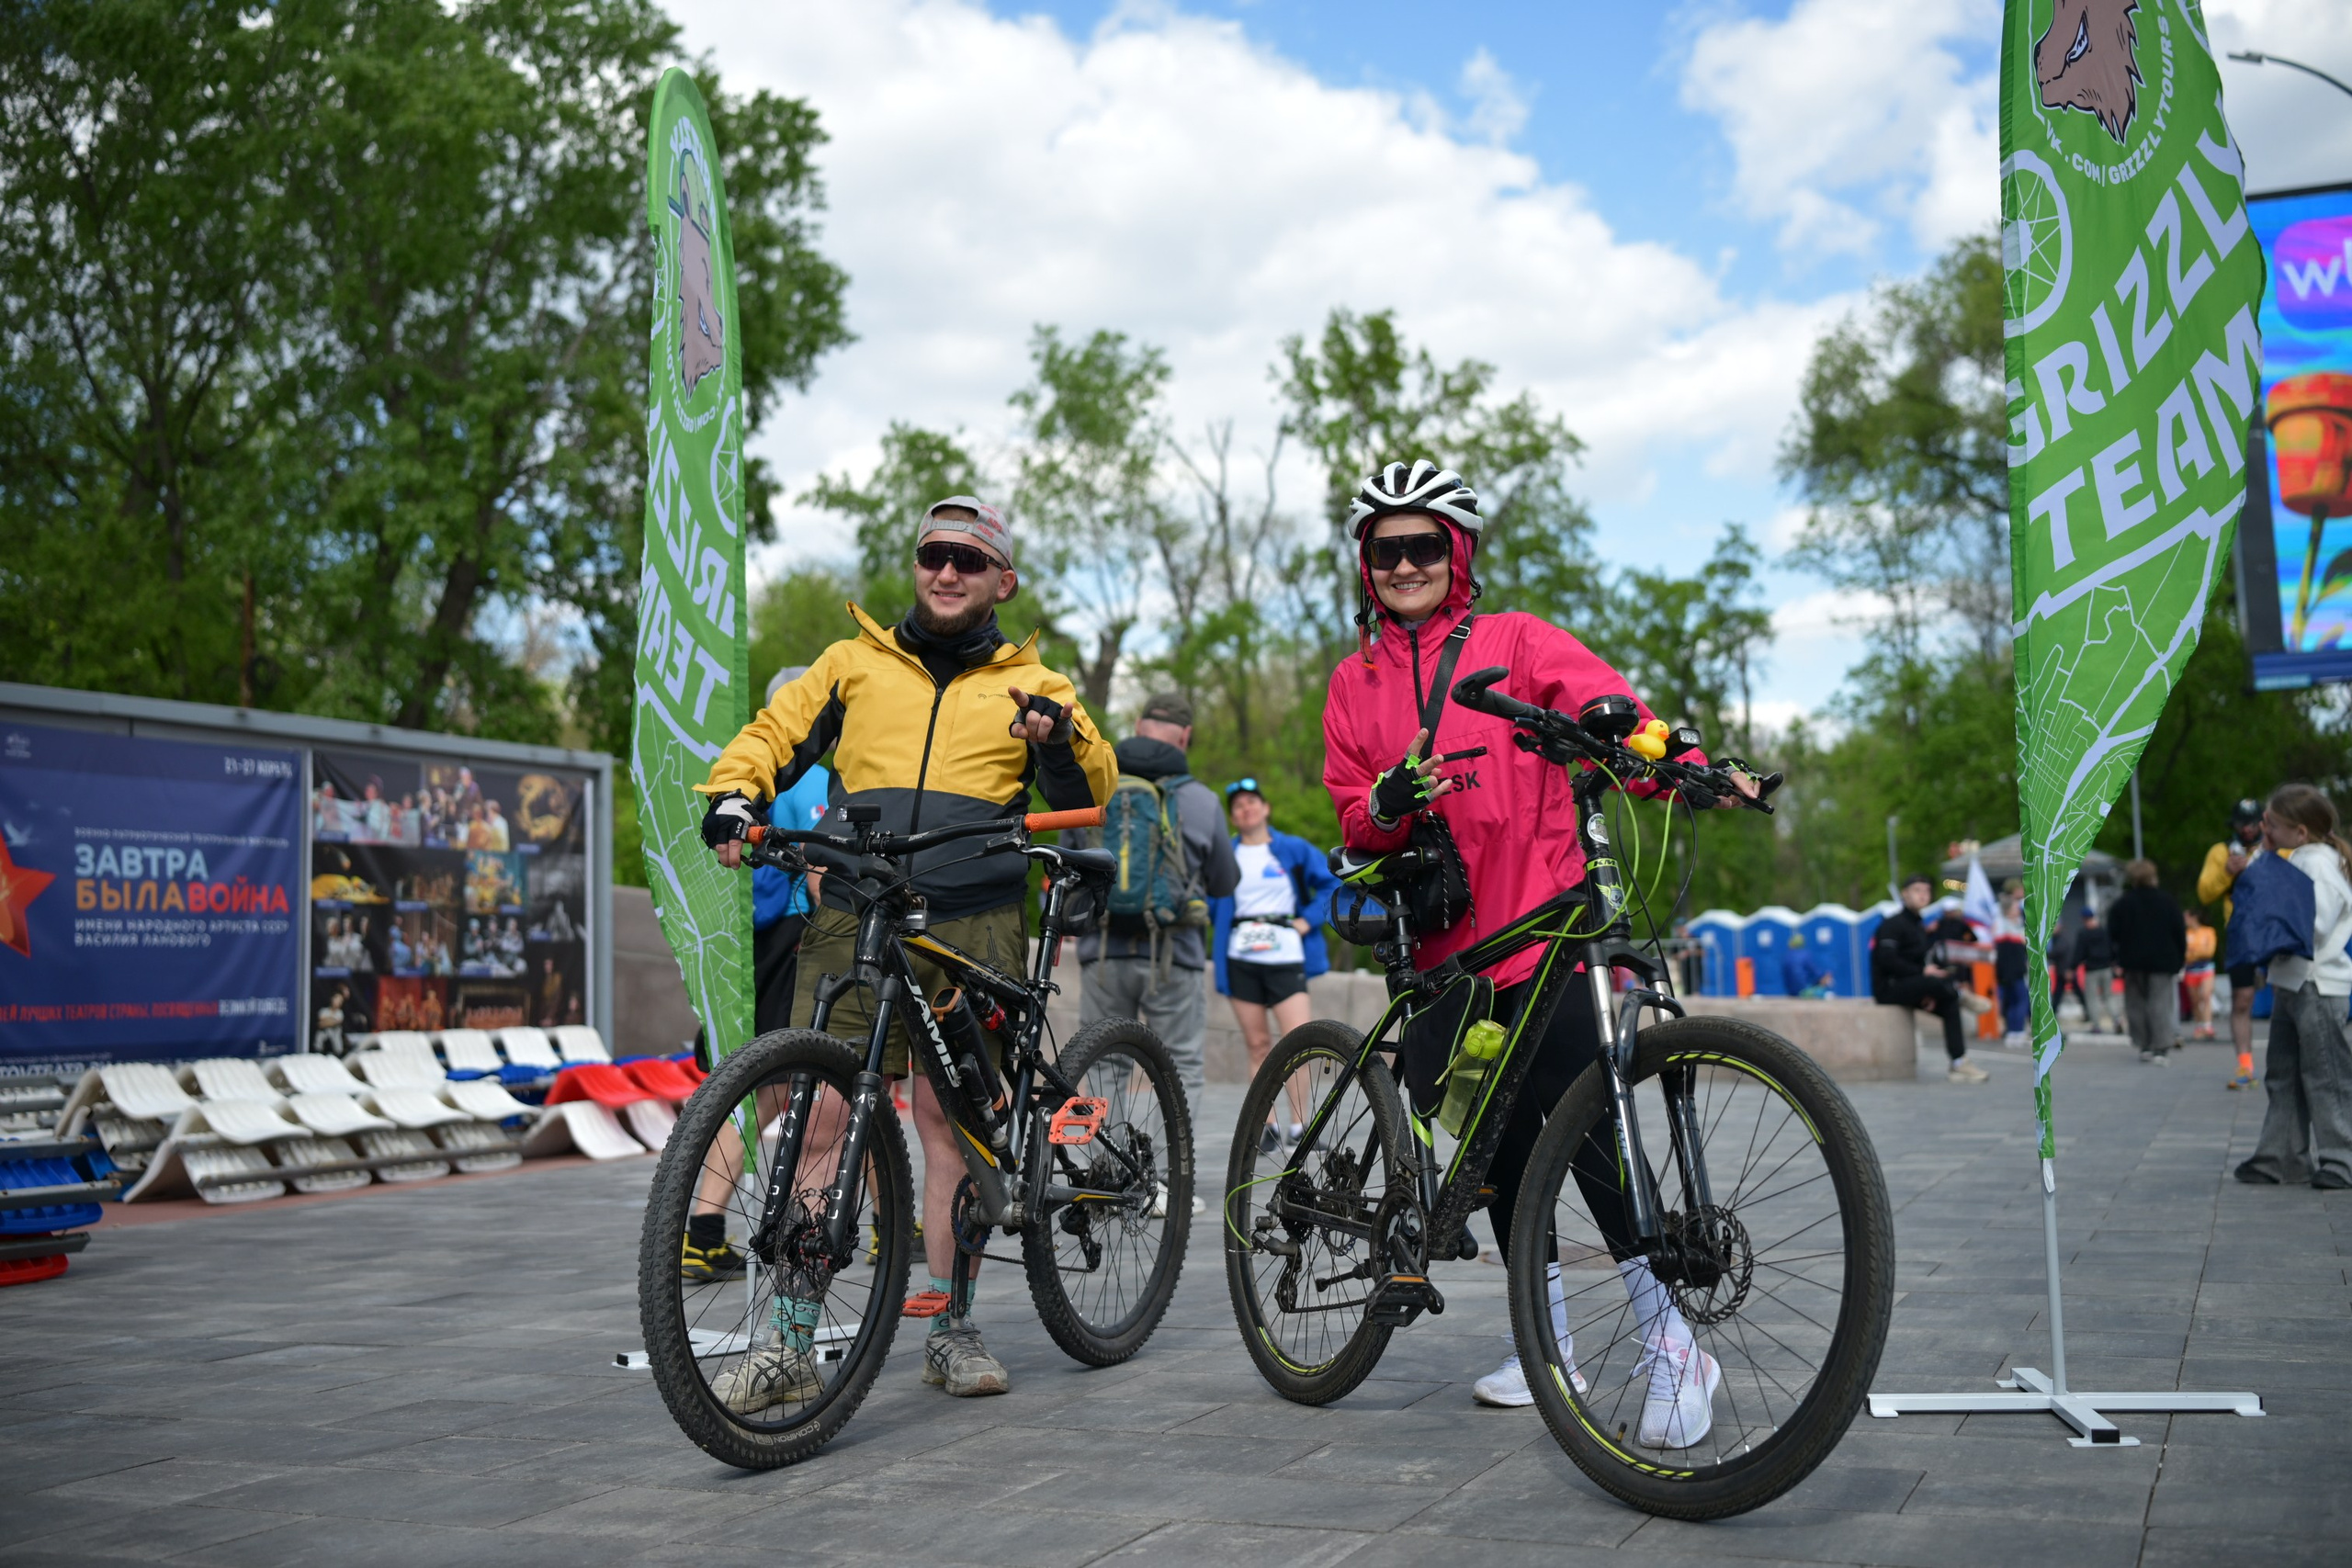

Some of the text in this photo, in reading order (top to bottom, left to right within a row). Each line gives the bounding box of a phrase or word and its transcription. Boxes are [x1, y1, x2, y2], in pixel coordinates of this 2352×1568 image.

[2282, 237, 2352, 300] w
[2027, 302, 2263, 573] TEAM
[74, 843, 209, 881] ЗАВТРА
[904, 975, 962, 1089] JAMIS
[827, 1092, 865, 1220] MANITOU
[773, 1426, 814, 1443] COMIRON
